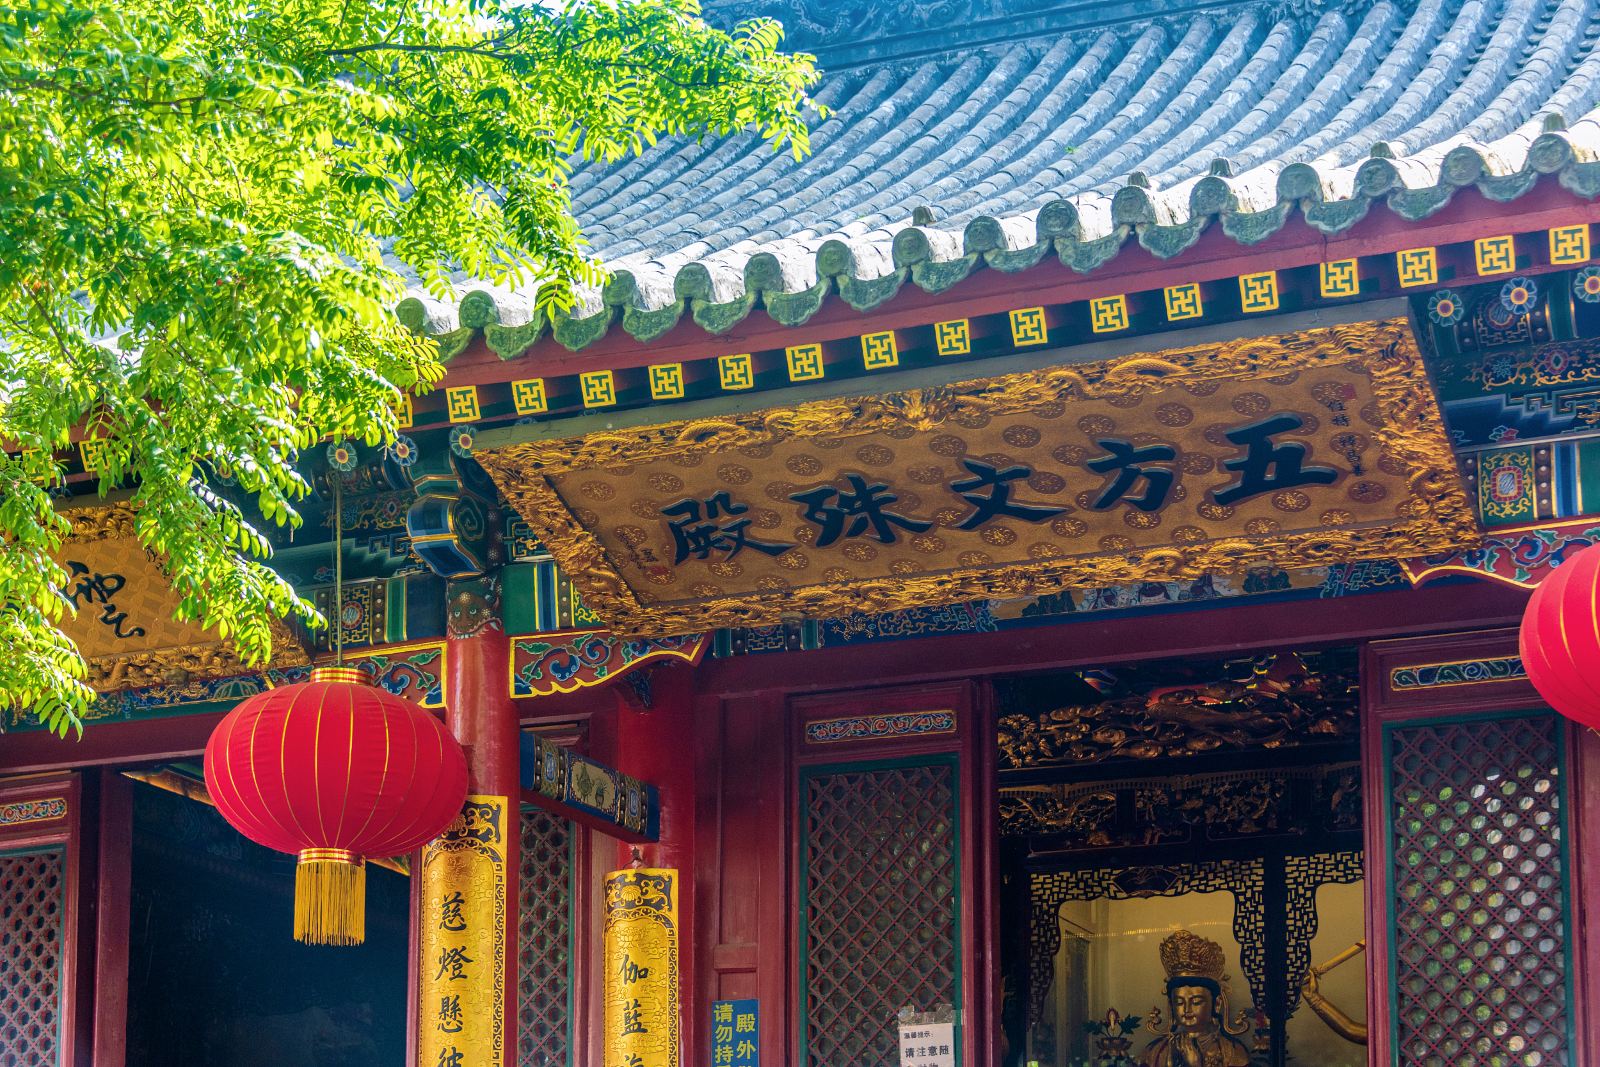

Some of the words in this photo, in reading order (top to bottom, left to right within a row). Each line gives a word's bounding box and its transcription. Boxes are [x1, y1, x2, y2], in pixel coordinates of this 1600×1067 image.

[660, 411, 1338, 566] 五方文殊殿
[618, 954, 649, 1067] 伽藍
[713, 1003, 734, 1067] 请勿持
[735, 1013, 757, 1067] 殿外
[904, 1045, 950, 1058] 请注意随
